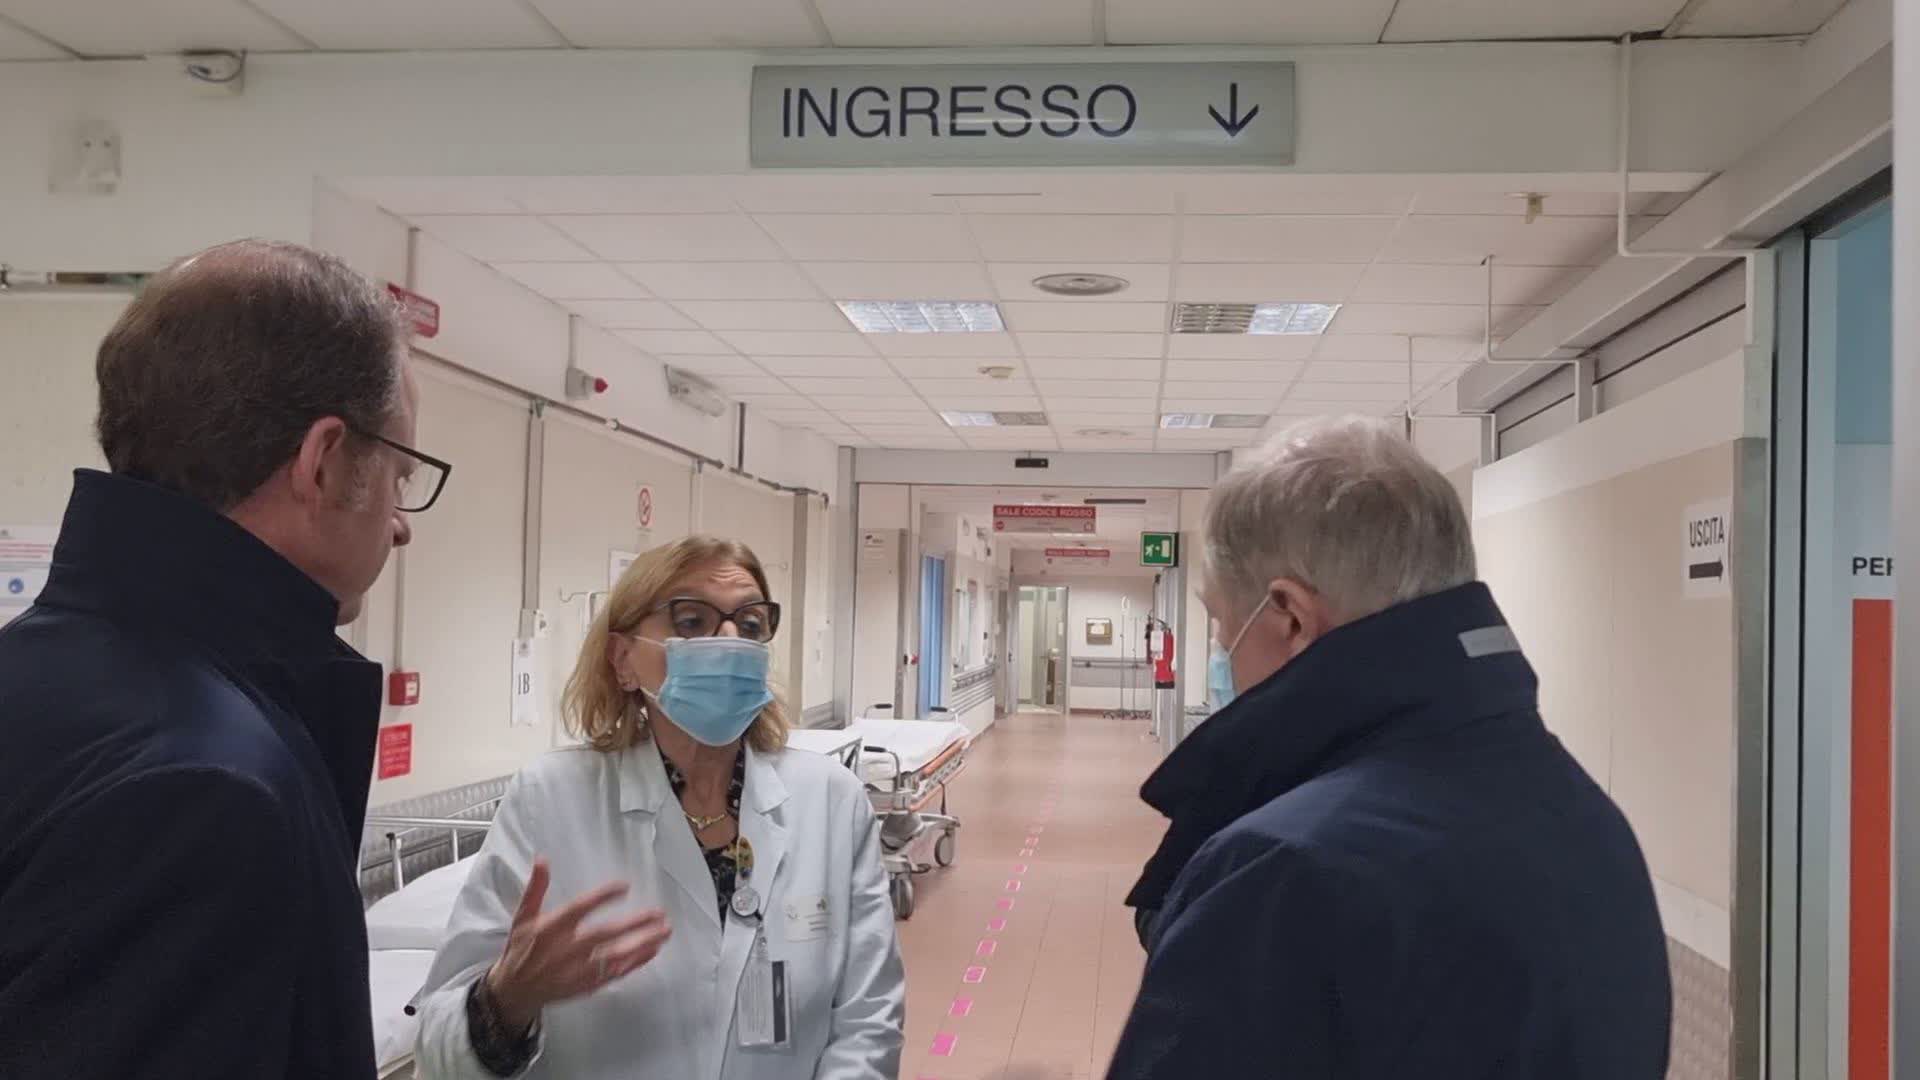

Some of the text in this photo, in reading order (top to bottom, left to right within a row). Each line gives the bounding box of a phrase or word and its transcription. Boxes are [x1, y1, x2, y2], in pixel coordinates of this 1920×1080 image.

[782, 84, 1136, 138] INGRESSO
[996, 507, 1093, 518] SALE CODICE ROSSO
[1689, 515, 1725, 547] USCITA
